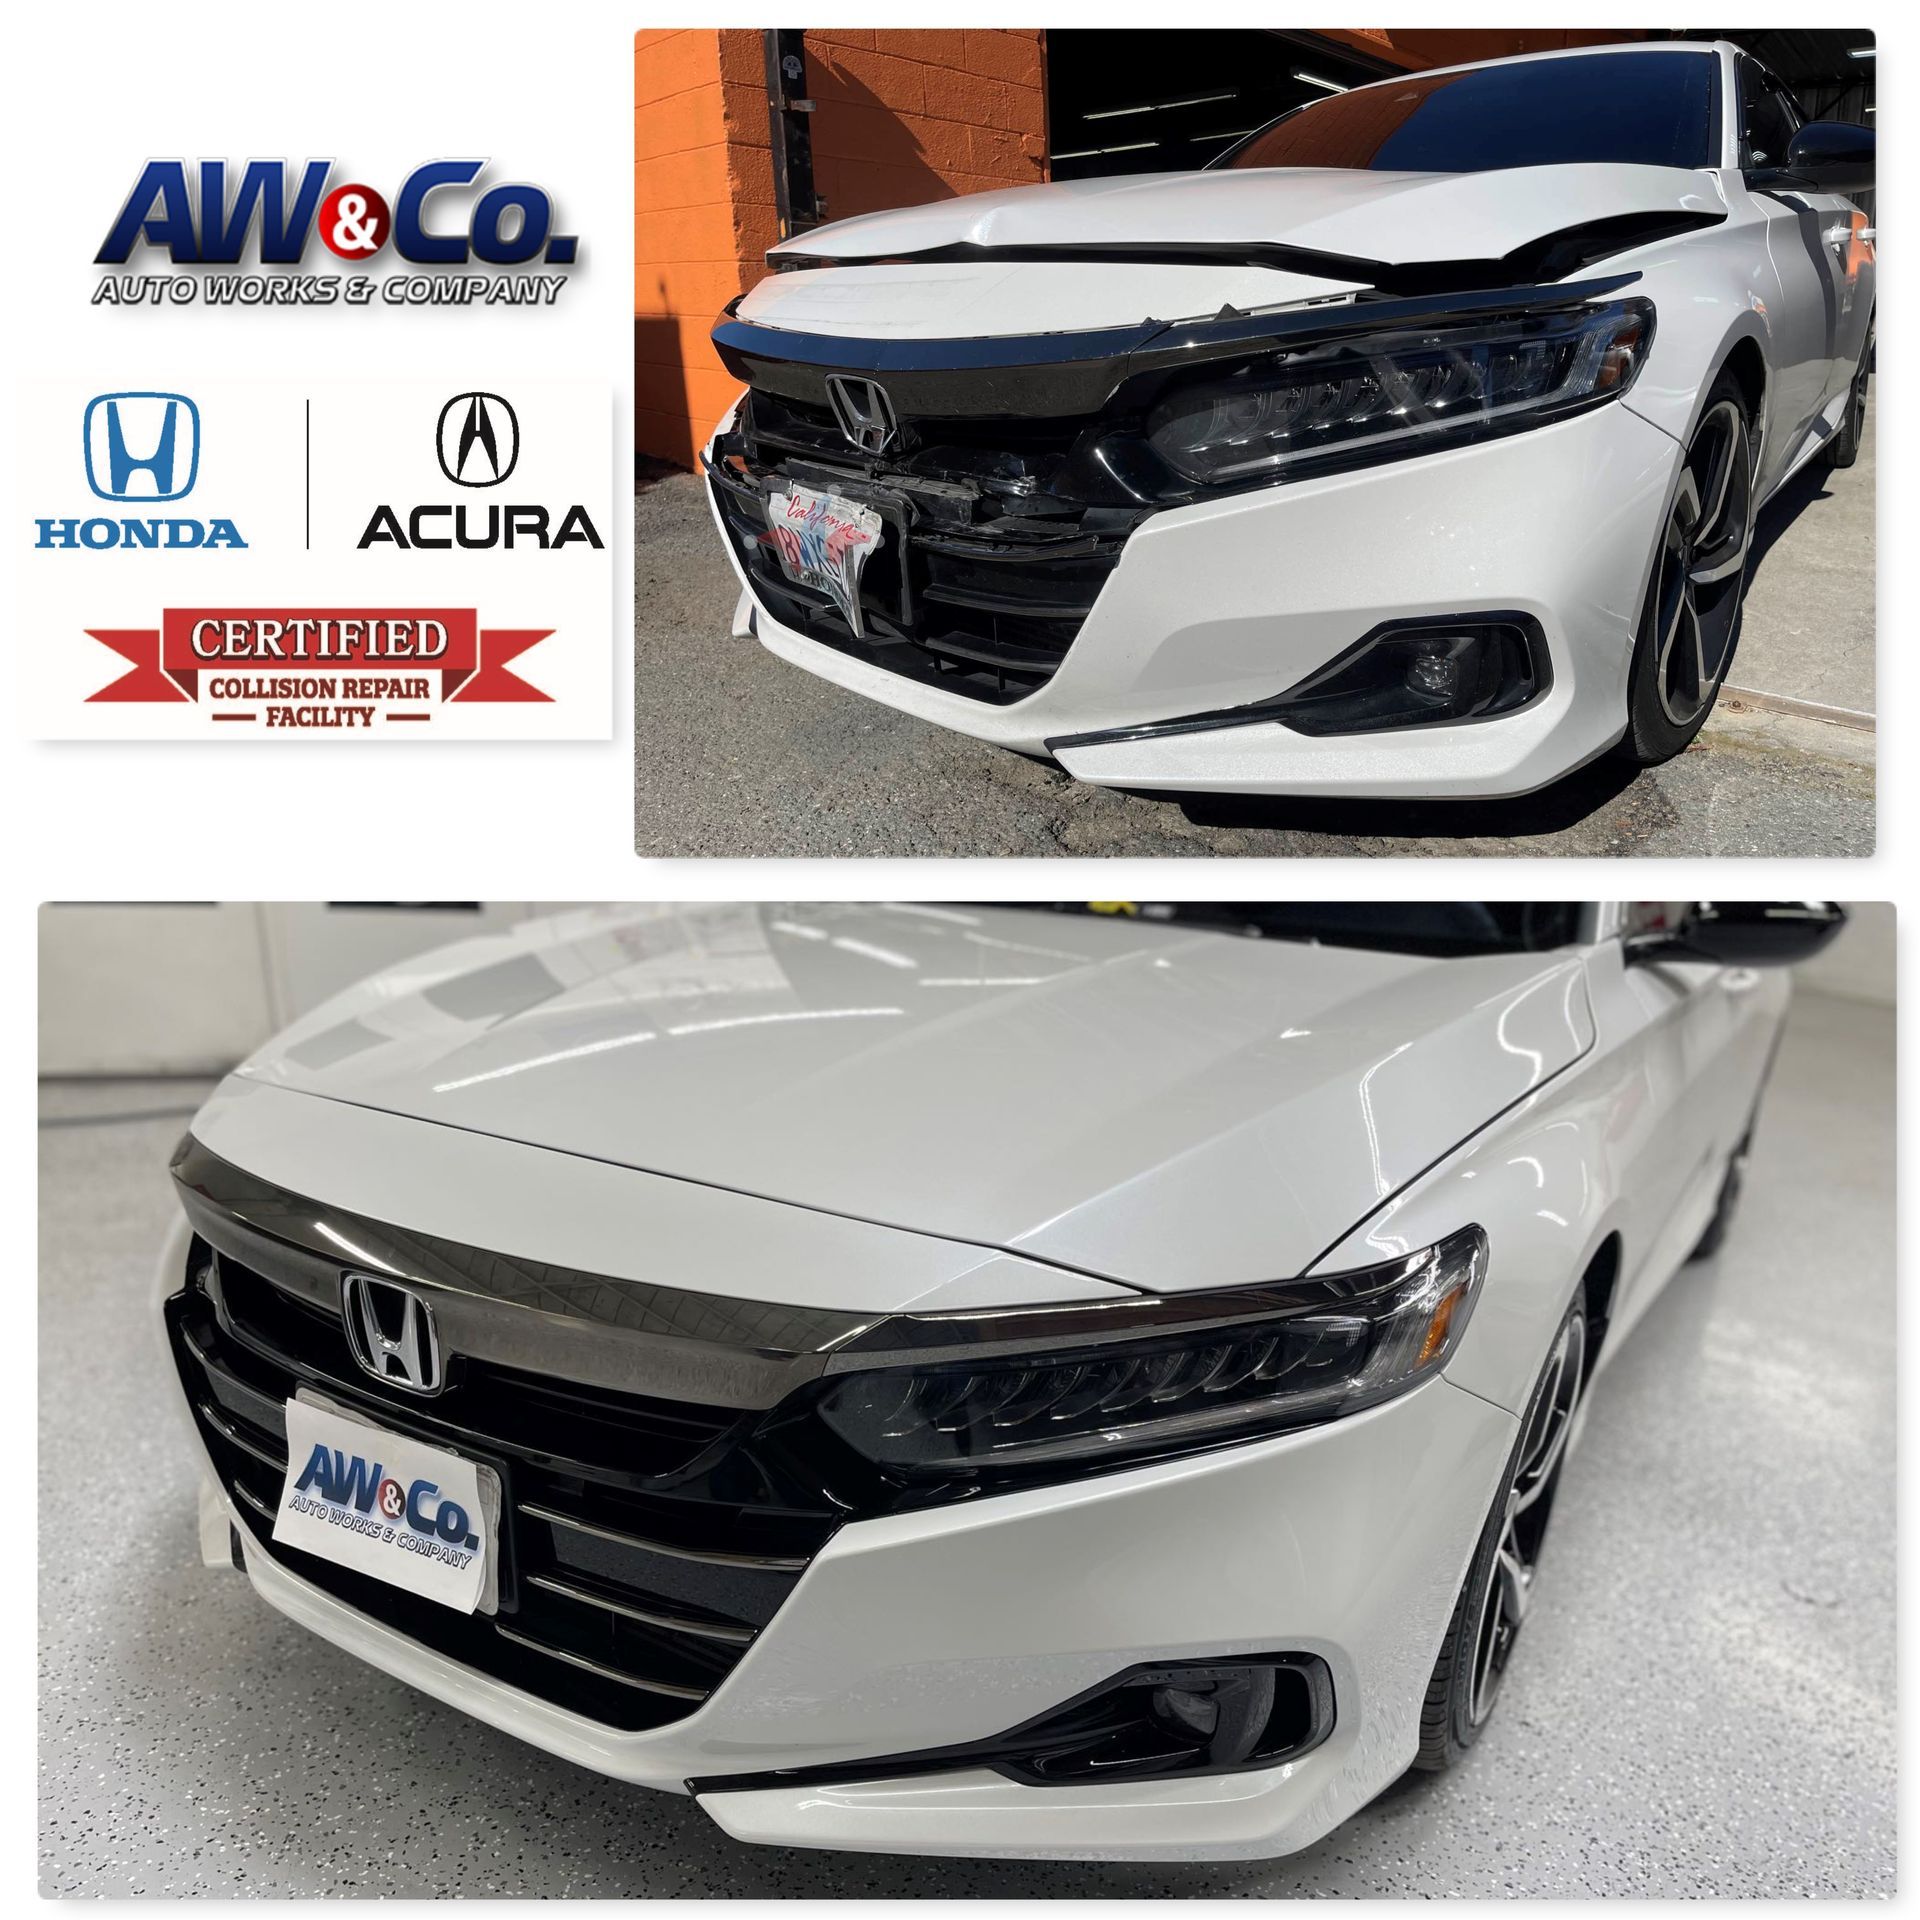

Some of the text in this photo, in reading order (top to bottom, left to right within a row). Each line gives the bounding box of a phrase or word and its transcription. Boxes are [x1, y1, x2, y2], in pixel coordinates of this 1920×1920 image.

[786, 495, 854, 539] California
[289, 1495, 472, 1570] AUTO WORKS & COMPANY
[294, 1443, 480, 1551] AW&Co.
